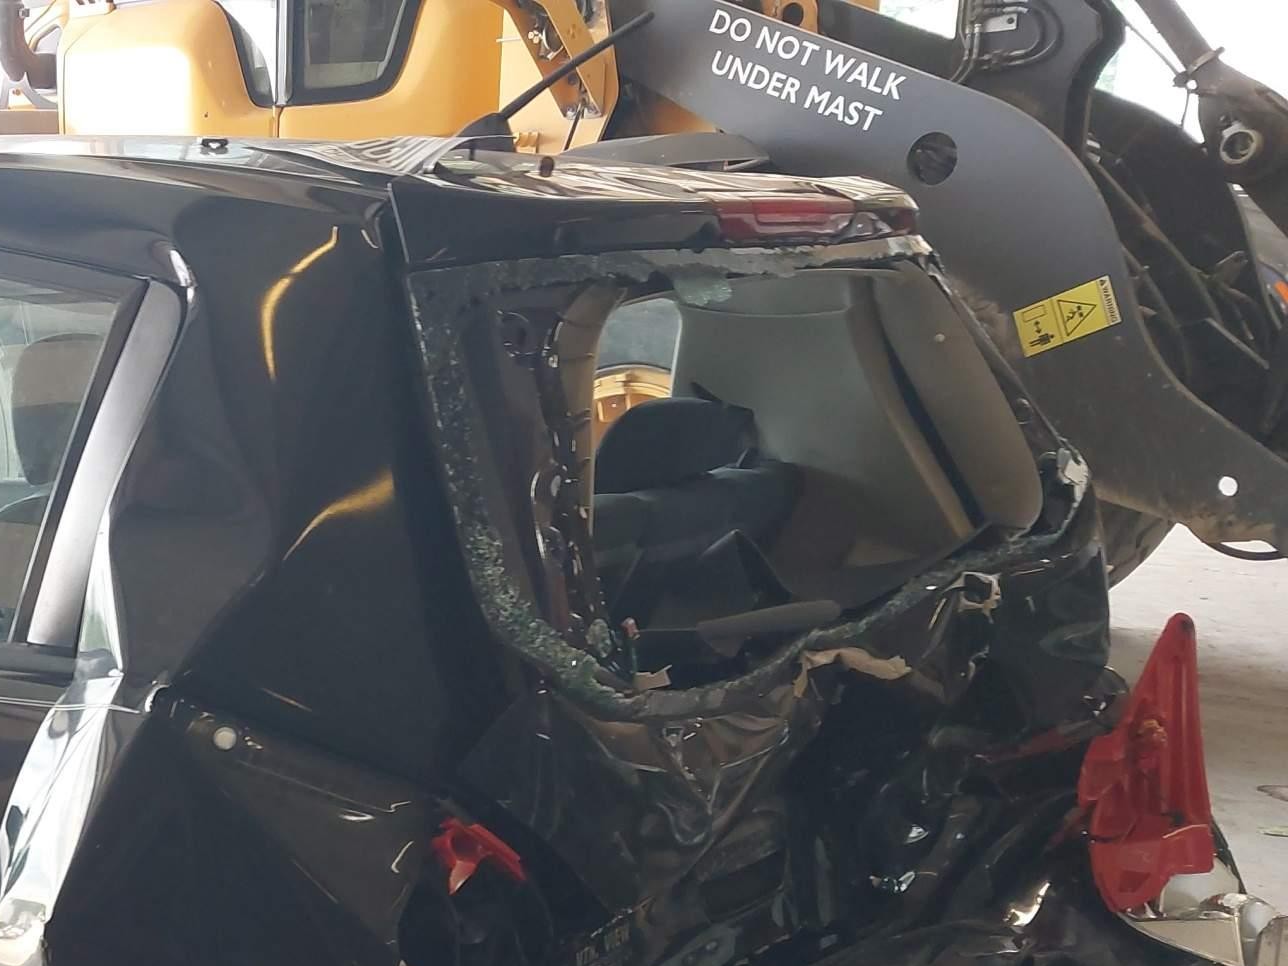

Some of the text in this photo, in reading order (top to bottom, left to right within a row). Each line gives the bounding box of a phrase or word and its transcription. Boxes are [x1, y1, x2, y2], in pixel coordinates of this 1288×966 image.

[709, 9, 907, 100] DO NOT WALK
[711, 50, 883, 131] UNDER MAST
